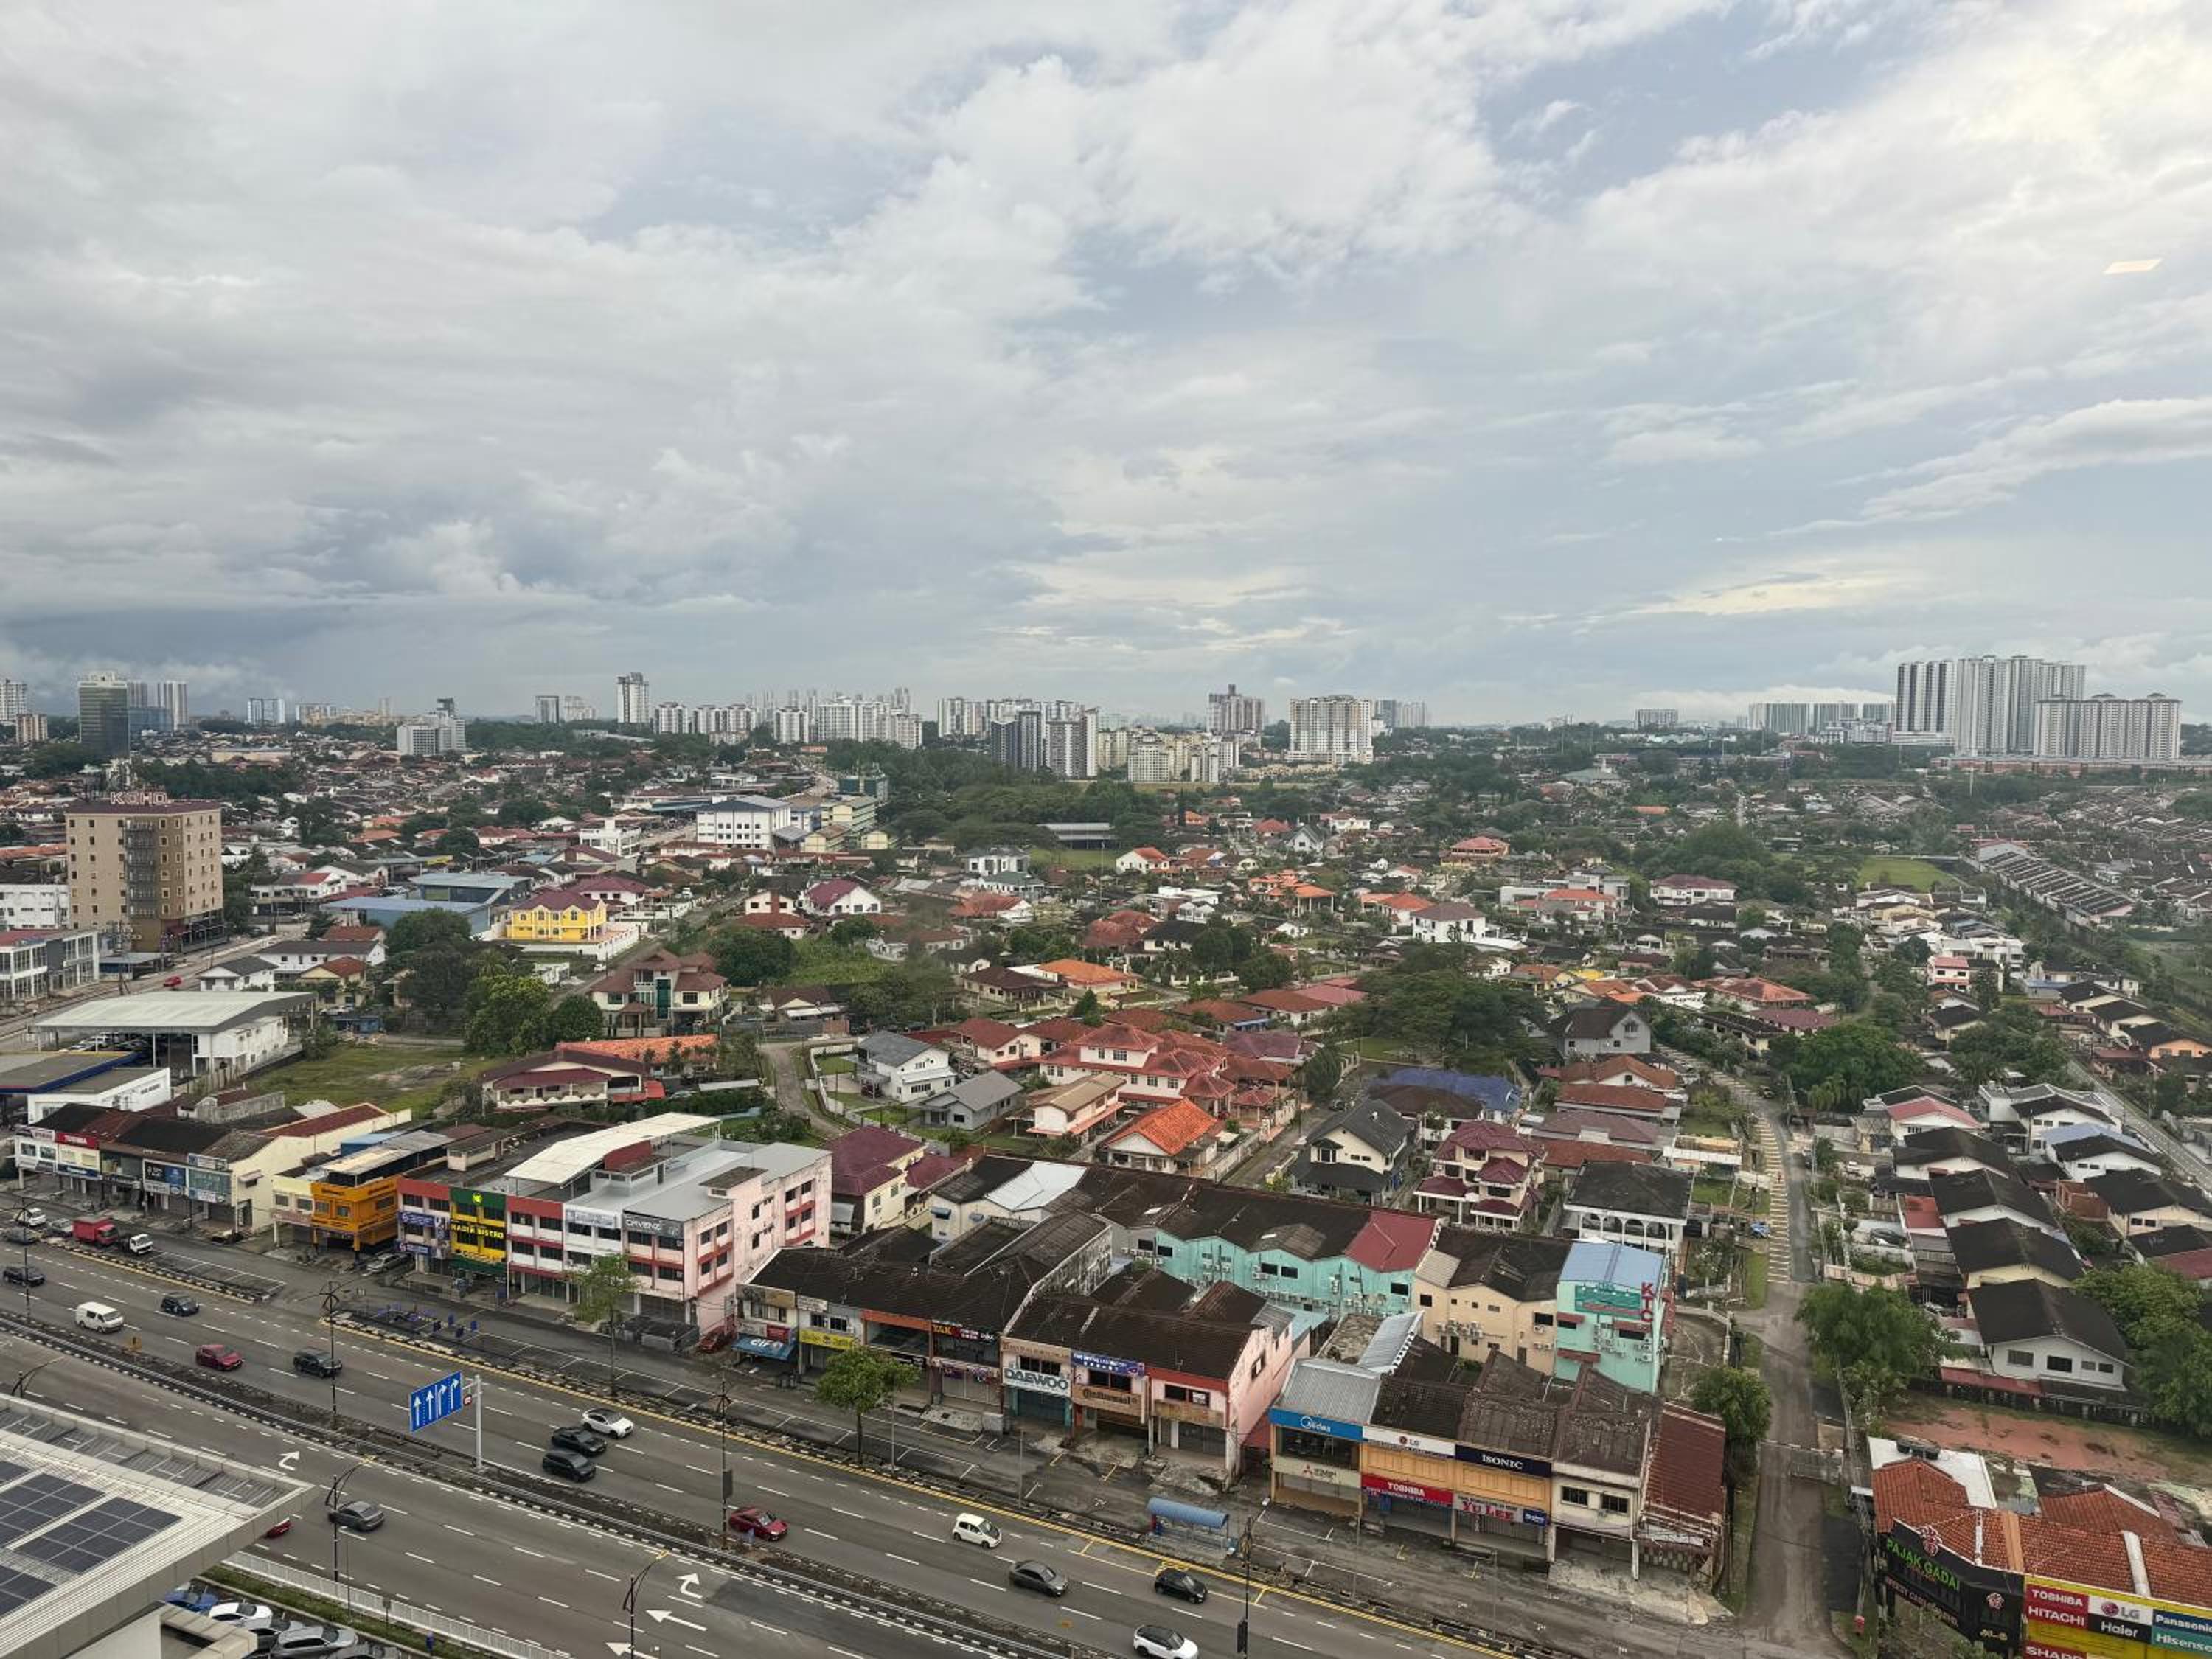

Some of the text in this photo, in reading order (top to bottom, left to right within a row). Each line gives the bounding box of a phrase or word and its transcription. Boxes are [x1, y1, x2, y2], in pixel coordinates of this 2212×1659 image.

[1004, 1368, 1068, 1390] DAEWOO
[1387, 1481, 1425, 1497] TOSHIBA
[1887, 1538, 1921, 1568] PAJAK
[1924, 1562, 1960, 1591] GADAI
[2031, 1589, 2084, 1607] TOSHIBA
[2028, 1606, 2085, 1627] HITACHI
[2121, 1607, 2140, 1619] LG
[2101, 1621, 2138, 1638] Haier
[2156, 1633, 2212, 1652] Hisense
